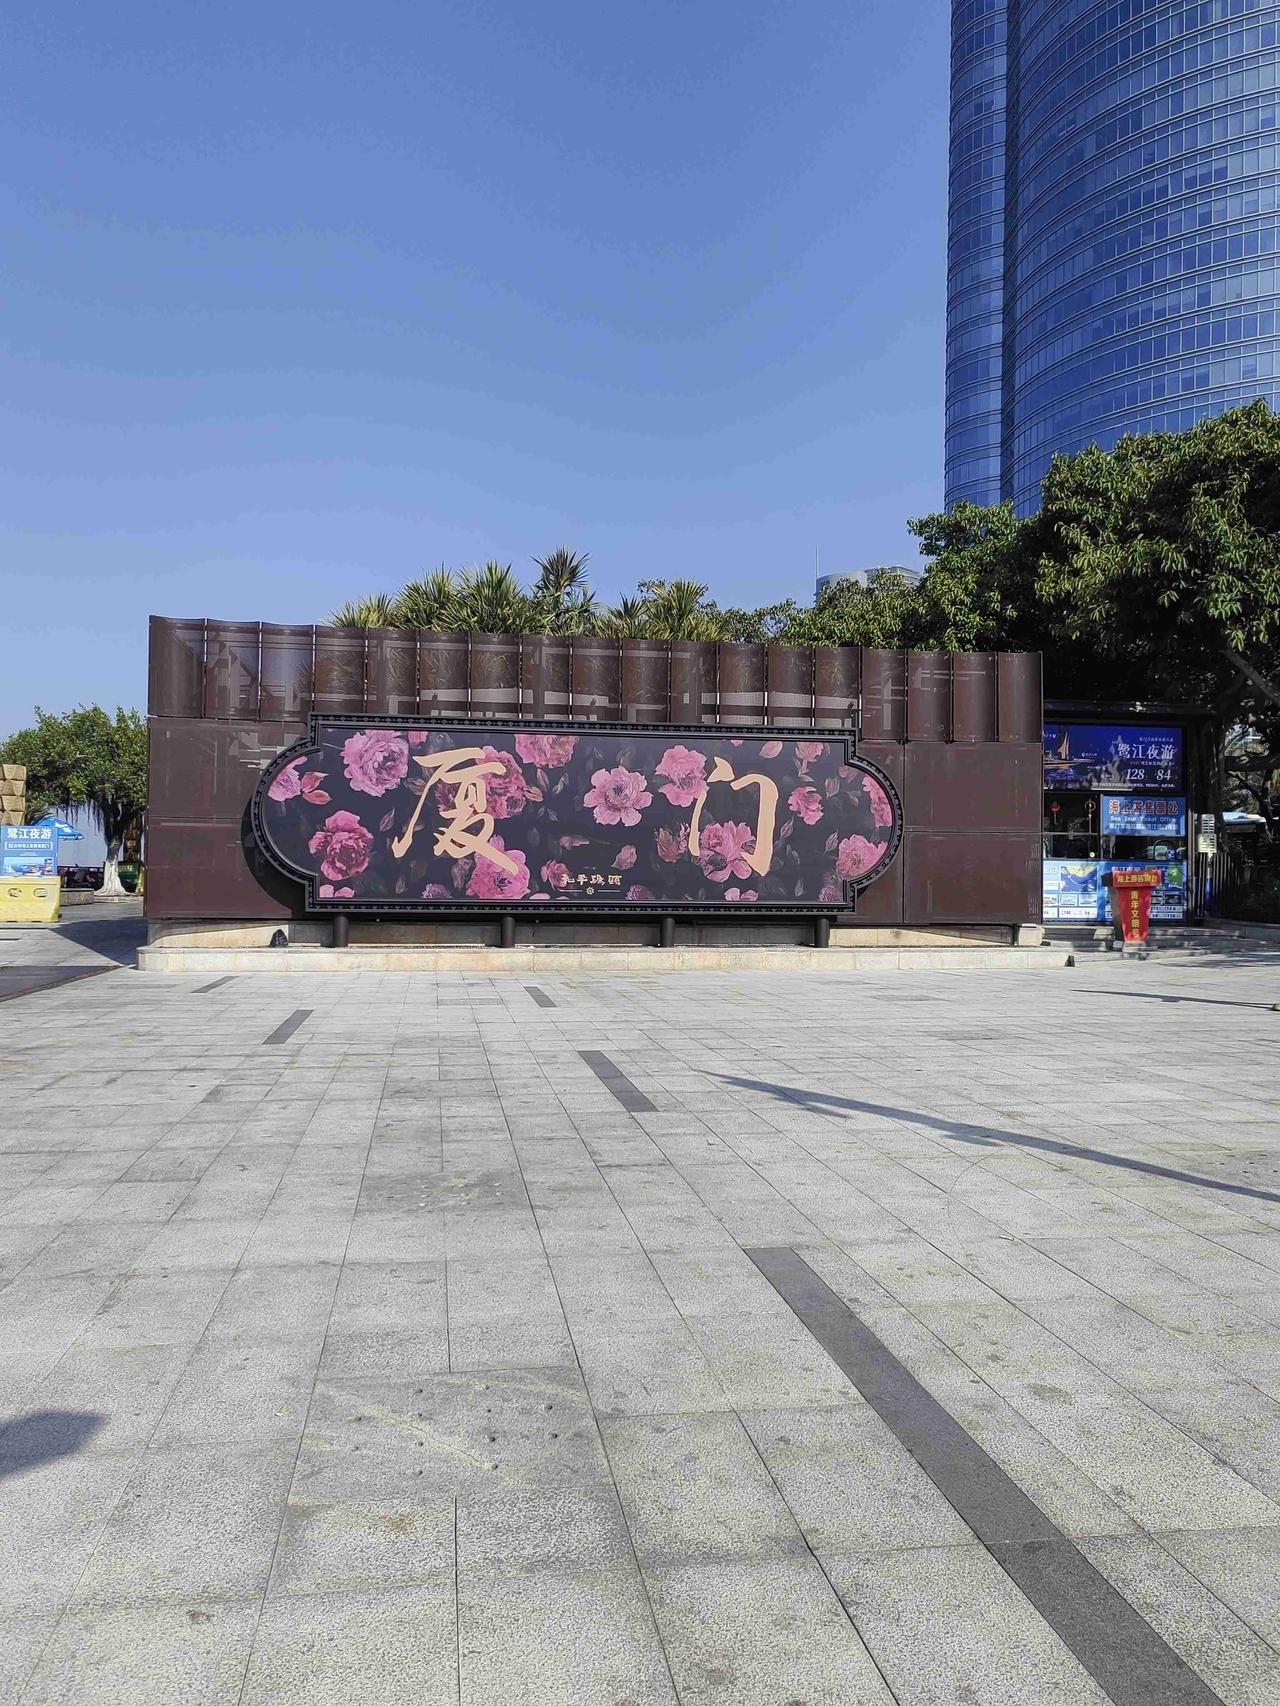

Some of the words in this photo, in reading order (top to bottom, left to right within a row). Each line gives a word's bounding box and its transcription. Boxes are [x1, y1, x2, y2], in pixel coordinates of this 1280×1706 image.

[1118, 743, 1177, 760] 鹭江夜游
[1126, 768, 1145, 781] 128
[1156, 769, 1172, 781] 84
[391, 747, 779, 877] 厦门
[1109, 799, 1179, 815] 海上游售票处
[8, 827, 52, 839] 鹭江夜游
